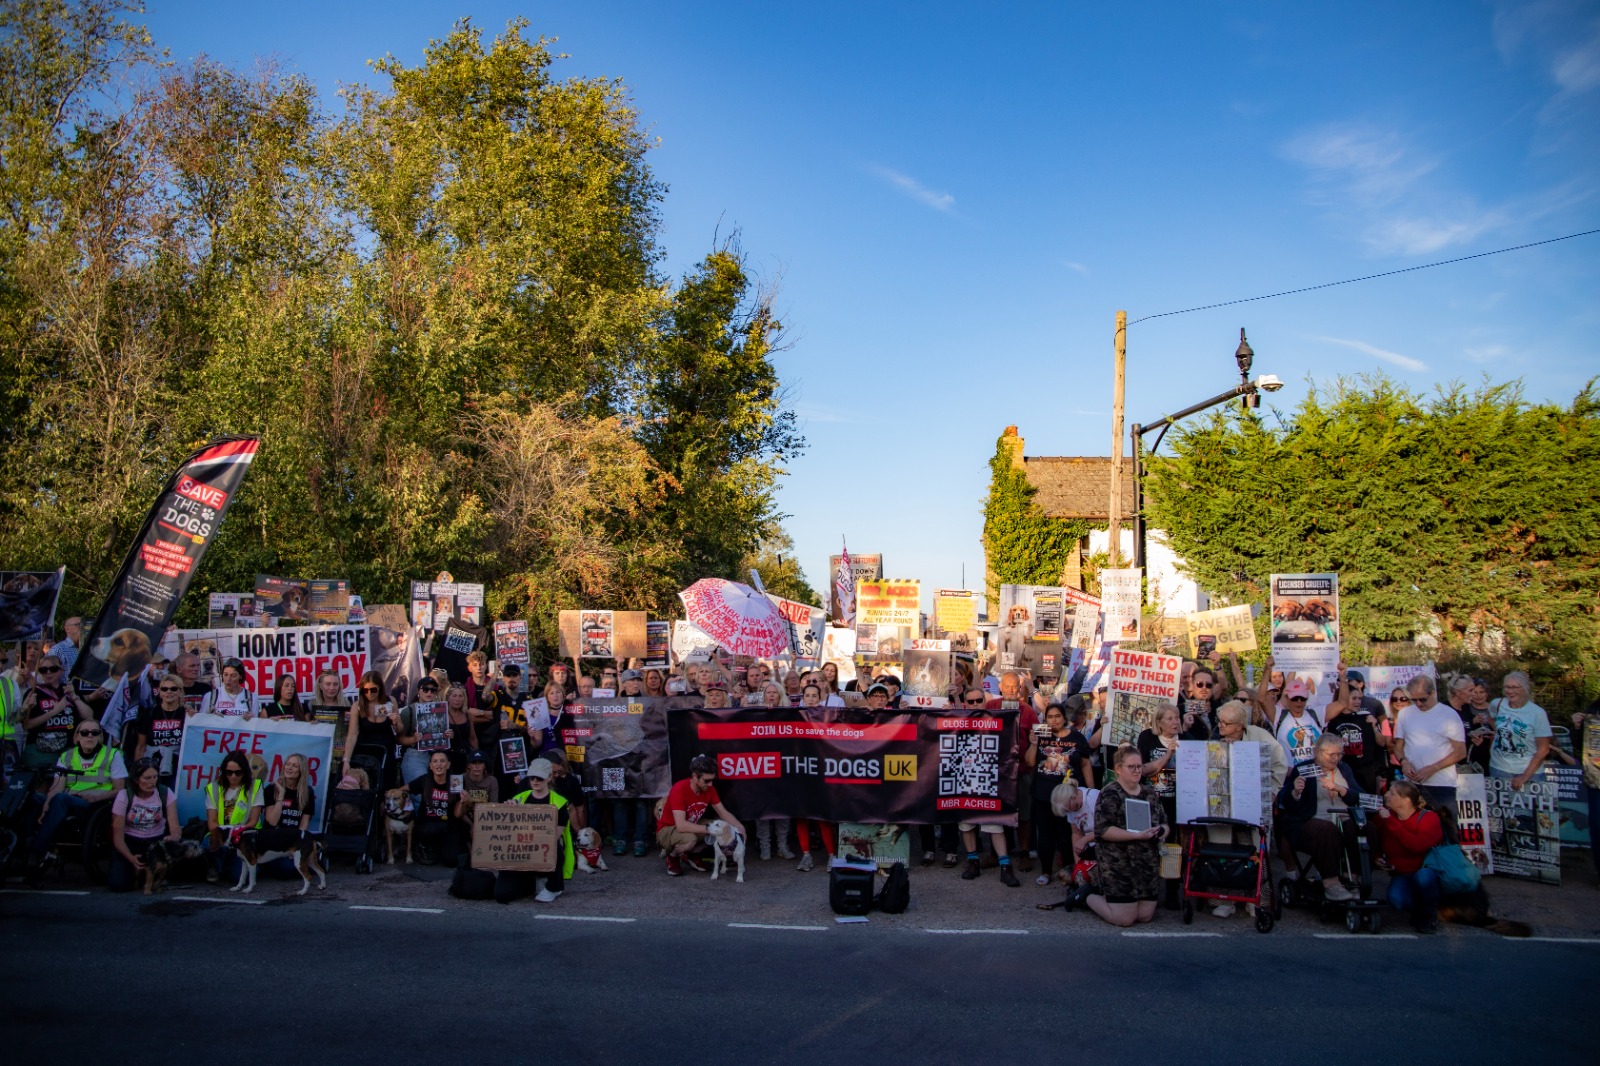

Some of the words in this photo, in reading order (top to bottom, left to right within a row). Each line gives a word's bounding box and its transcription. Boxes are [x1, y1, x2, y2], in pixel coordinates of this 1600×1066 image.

[181, 480, 223, 506] SAVE
[174, 494, 200, 515] THE
[163, 508, 211, 537] DOGS
[1279, 581, 1304, 589] LICENSED
[369, 605, 400, 614] SAVE
[779, 601, 810, 624] SAVE
[1190, 617, 1224, 633] SAVE
[1225, 612, 1251, 626] THE
[239, 633, 297, 659] HOME
[303, 629, 365, 654] OFFICE
[446, 642, 472, 653] ACRES
[450, 636, 471, 647] MBR
[912, 640, 942, 650] SAVE
[1114, 652, 1153, 667] TIME
[1158, 657, 1178, 671] TO
[1114, 667, 1137, 678] END
[1141, 670, 1175, 683] THEIR
[1112, 680, 1175, 698] SUFFERING
[917, 697, 932, 705] US
[603, 705, 627, 713] DOGS
[47, 715, 74, 725] DOGS
[155, 721, 181, 729] SAVE
[942, 720, 969, 728] CLOSE
[972, 720, 998, 729] DOWN
[751, 725, 775, 736] JOIN
[779, 725, 792, 735] US
[795, 727, 804, 735] to
[806, 728, 824, 736] save
[826, 728, 840, 736] the
[843, 728, 864, 738] dogs
[202, 729, 267, 754] FREE
[721, 756, 776, 777] SAVE
[782, 756, 818, 775] THE
[824, 759, 880, 777] DOGS
[889, 760, 912, 776] UK
[432, 790, 448, 800] AVE
[1530, 783, 1552, 795] ON
[941, 799, 960, 808] MBR
[964, 800, 996, 809] ACRES
[1486, 791, 1554, 812] DEATH
[479, 811, 508, 822] ANDY
[510, 812, 553, 823] BURNHAM
[1487, 807, 1515, 818] ROW
[517, 833, 534, 842] DIE
[507, 844, 539, 853] FLAWED
[541, 844, 550, 862] ?
